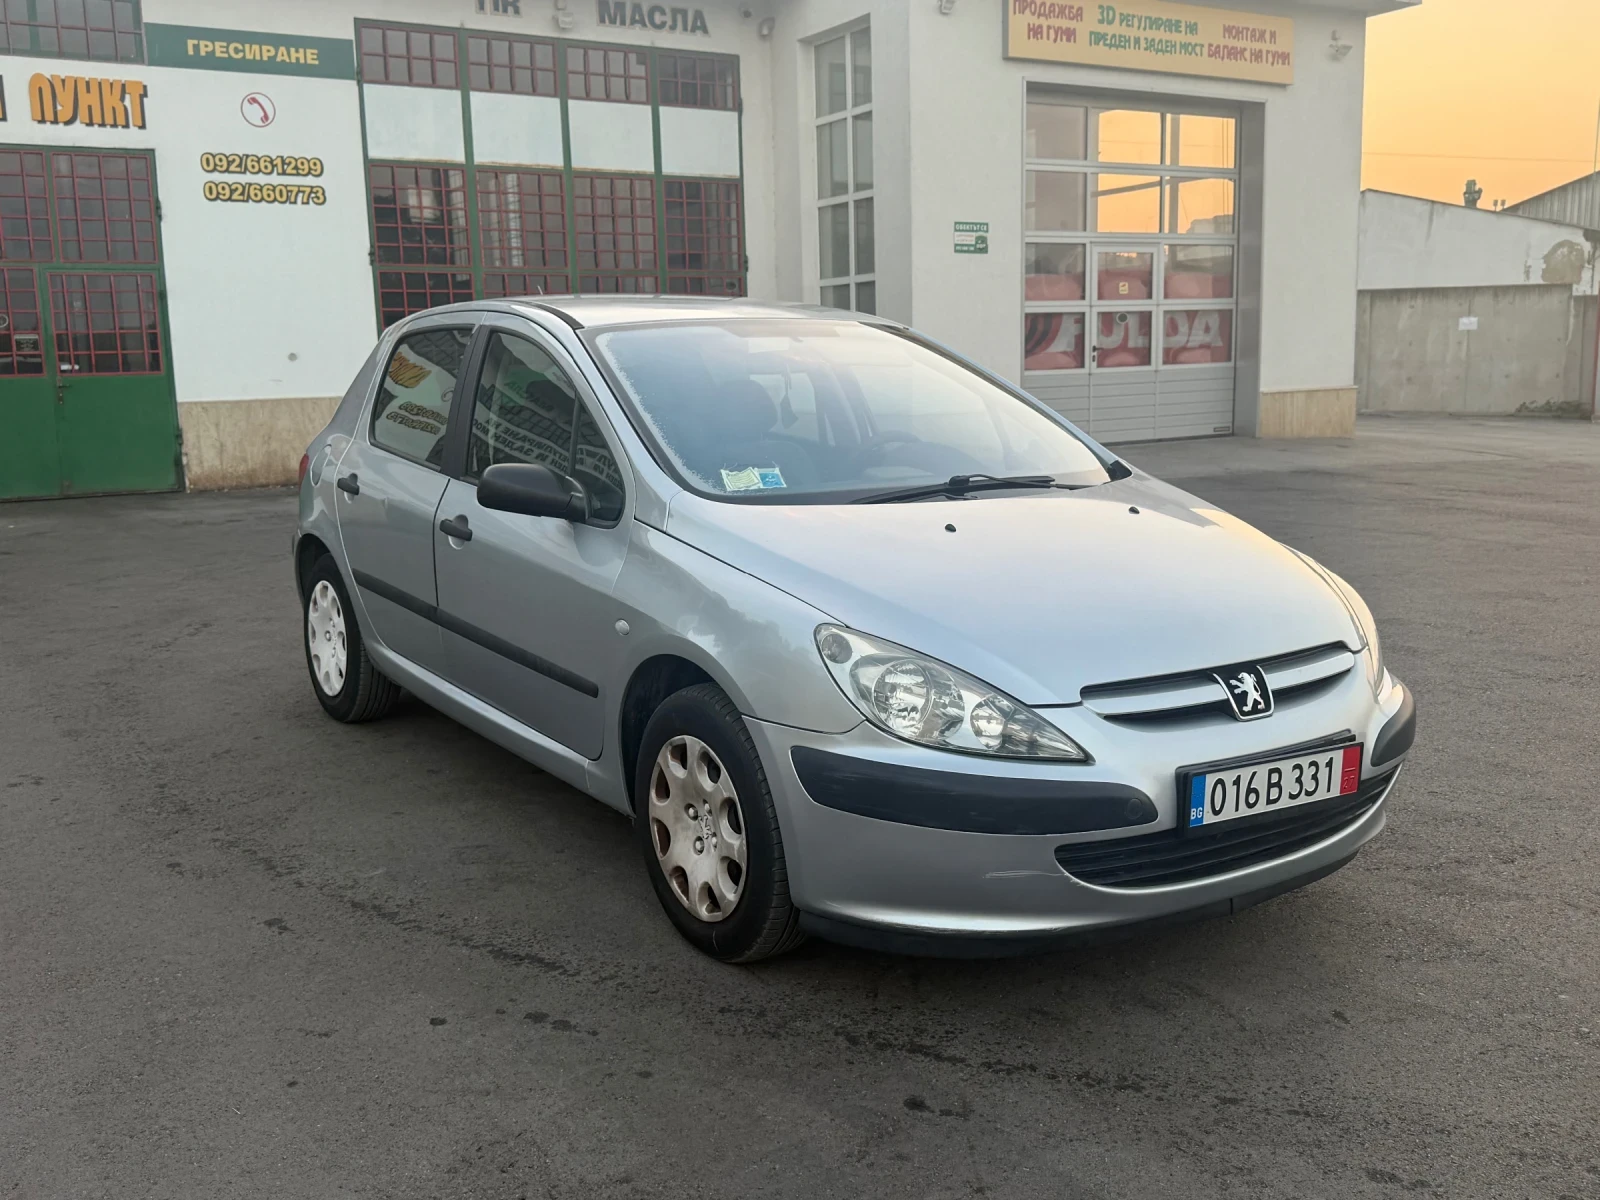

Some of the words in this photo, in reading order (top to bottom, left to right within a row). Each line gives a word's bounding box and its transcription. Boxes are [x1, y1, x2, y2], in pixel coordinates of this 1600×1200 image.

[599, 0, 710, 35] МАСЛА
[1013, 0, 1083, 22] ПРОДАЖБА
[1097, 4, 1116, 25] 3D
[1119, 12, 1182, 34] РЕГУЛИРАНЕ
[1185, 20, 1198, 36] НА
[1027, 22, 1043, 40] НА
[1046, 25, 1076, 43] ГУМИ
[1089, 30, 1131, 50] ПРЕДЕН
[1133, 35, 1141, 50] И
[1144, 37, 1177, 55] ЗАДЕН
[1179, 40, 1205, 57] МОСТ
[1222, 24, 1267, 43] МОНТАЖ
[1269, 30, 1277, 44] И
[186, 39, 320, 65] ГРЕСИРАНЕ
[1207, 43, 1248, 62] БАЛАНС
[1250, 48, 1263, 64] НА
[1265, 50, 1290, 67] ГУМИ
[28, 72, 147, 129] ПУНКТ
[200, 152, 323, 177] 092/661299
[203, 181, 327, 205] 092/660773
[1210, 756, 1334, 816] 016B331
[1190, 808, 1203, 820] BG
